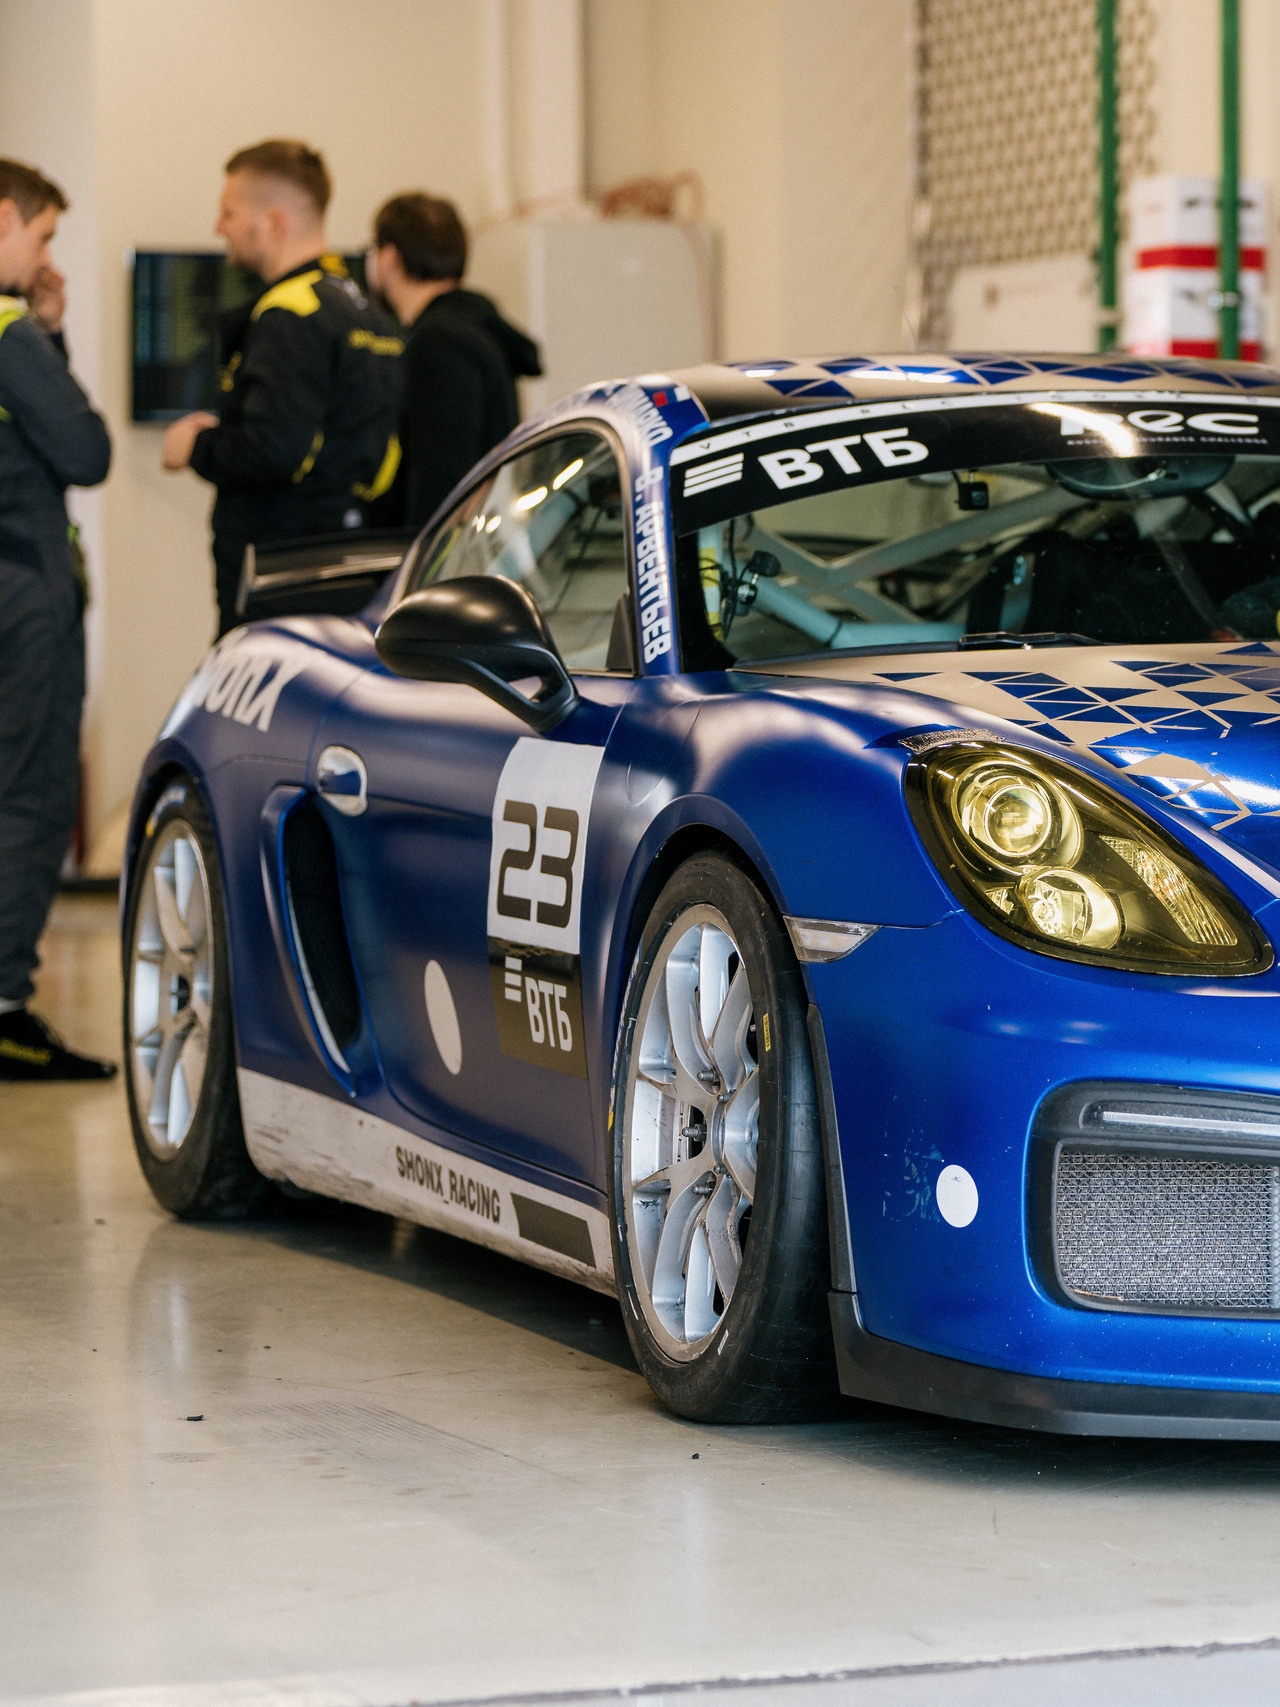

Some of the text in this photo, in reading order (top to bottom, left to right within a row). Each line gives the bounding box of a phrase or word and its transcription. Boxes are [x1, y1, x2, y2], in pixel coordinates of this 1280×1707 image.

[758, 427, 930, 490] ВТБ
[635, 501, 672, 664] АРВЕНТЬЕВ
[497, 799, 580, 930] 23
[525, 976, 573, 1053] ВТБ
